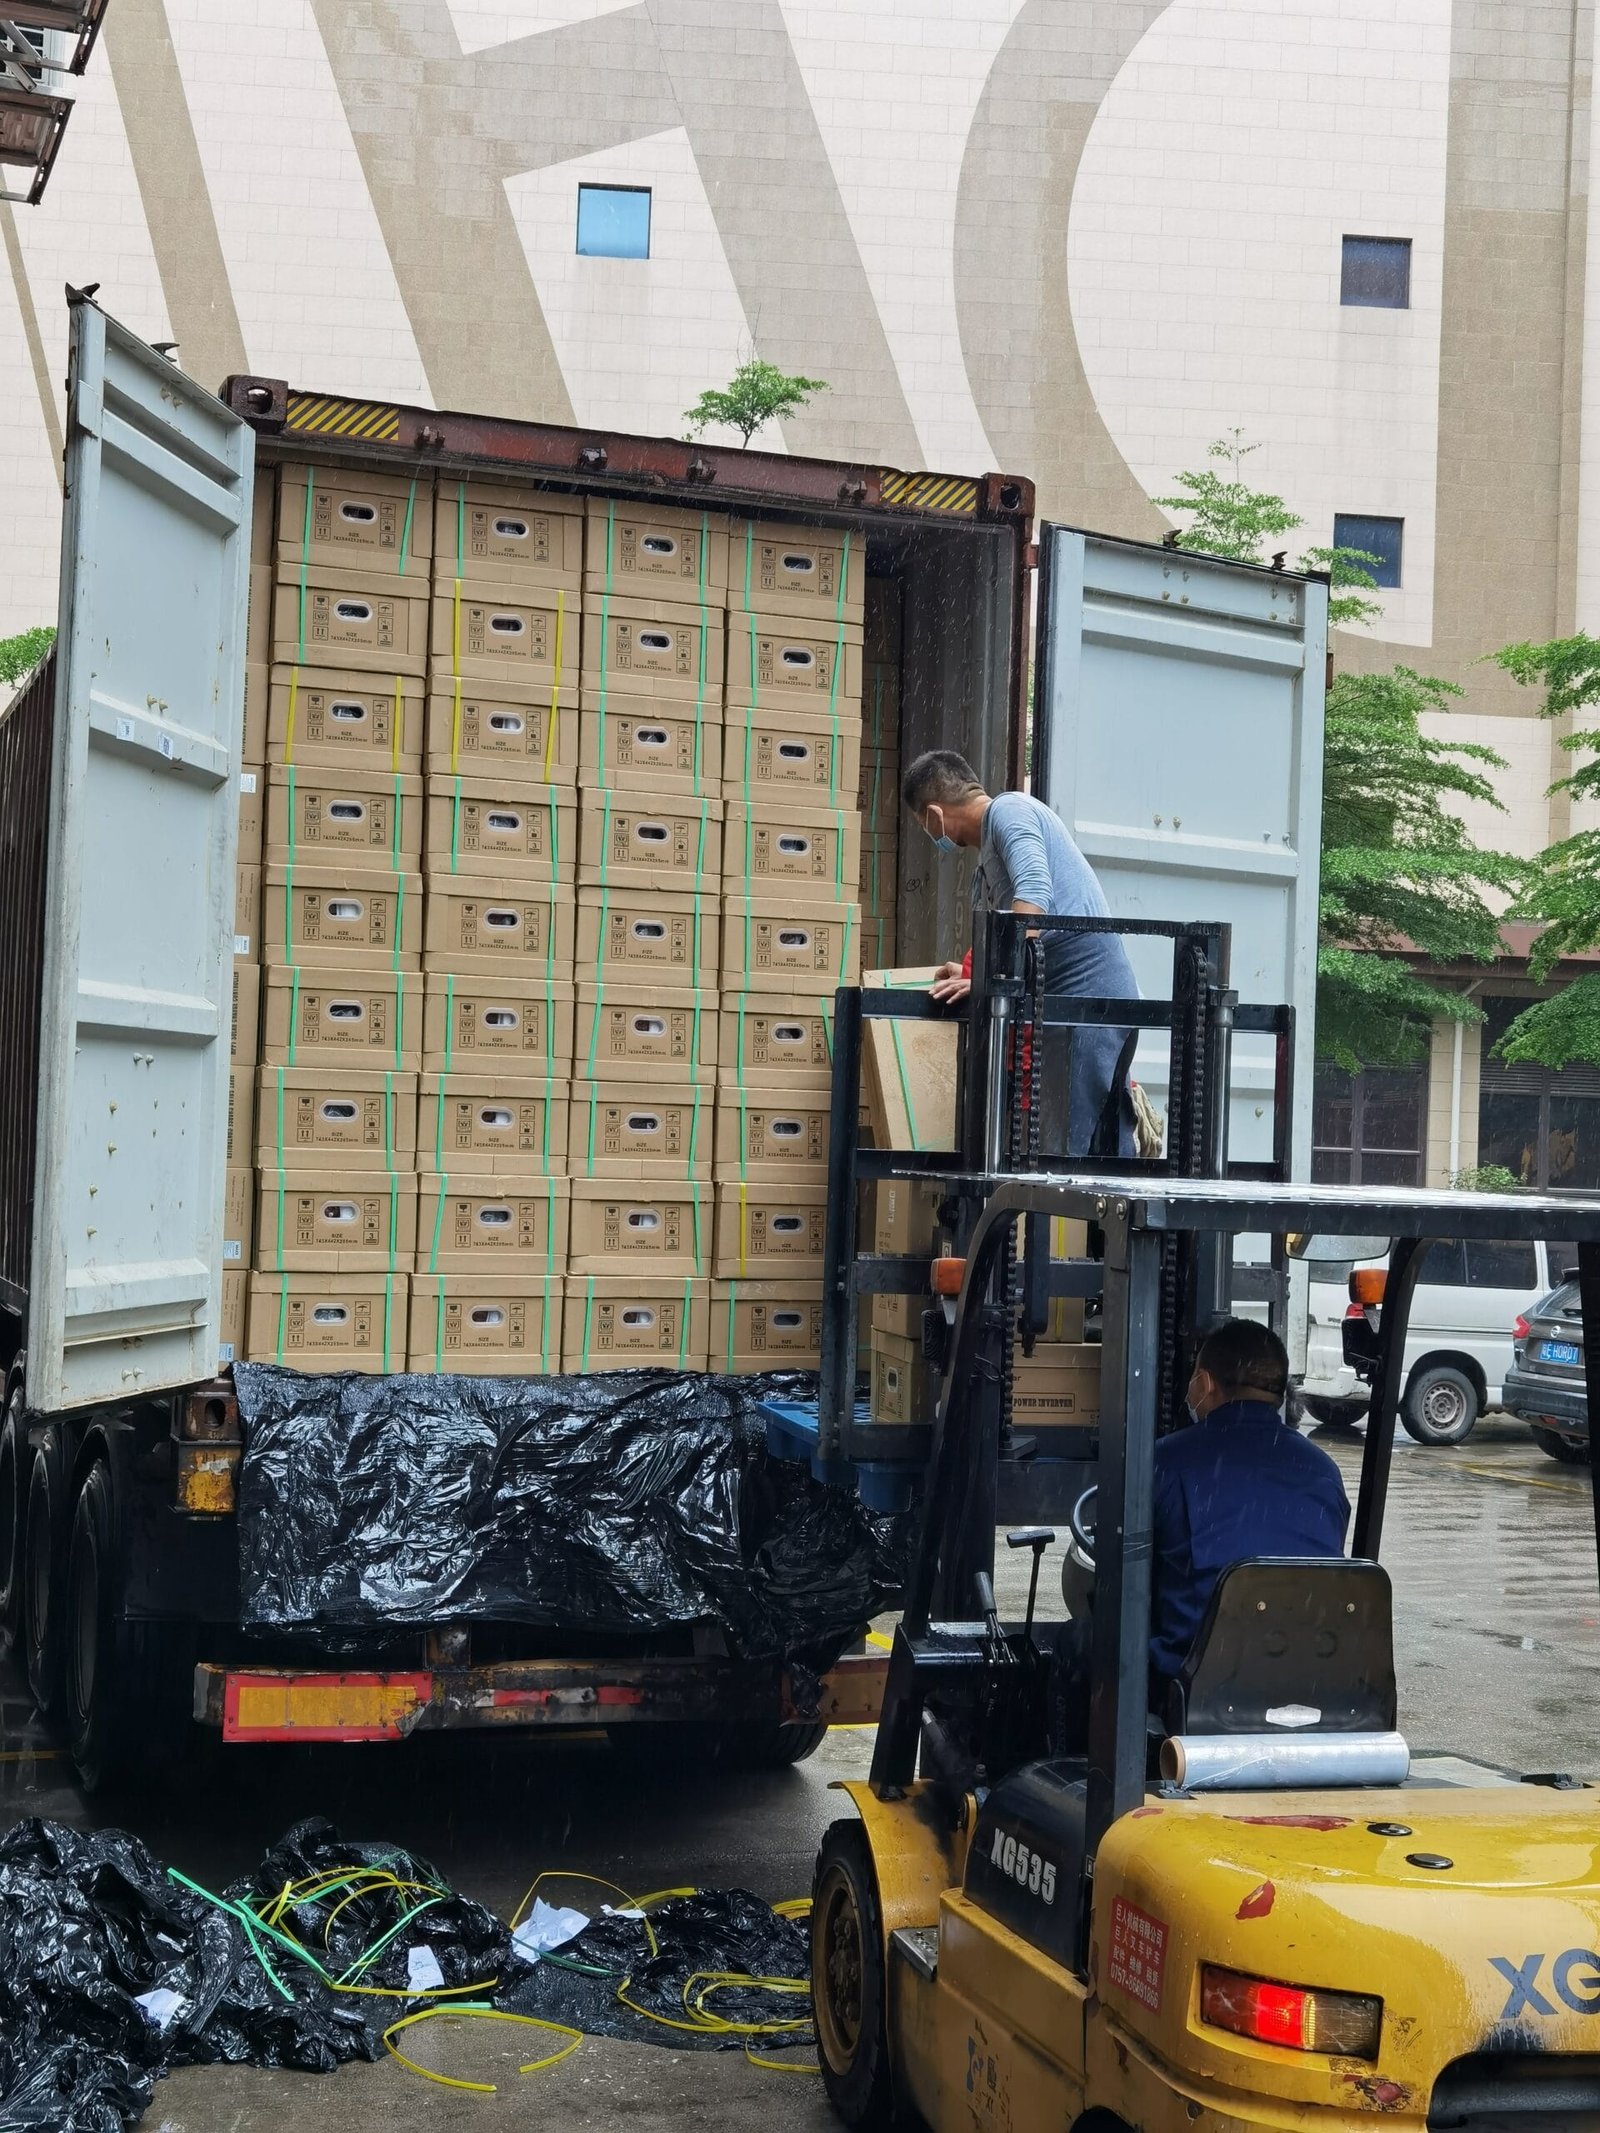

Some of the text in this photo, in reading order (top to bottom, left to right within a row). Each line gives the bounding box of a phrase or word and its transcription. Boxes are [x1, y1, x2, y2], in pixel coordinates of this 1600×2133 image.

[1014, 1398, 1072, 1408] POWER INVERTER
[990, 1827, 1056, 1904] XG535
[1116, 1904, 1163, 1949] 巨人机械有限公司
